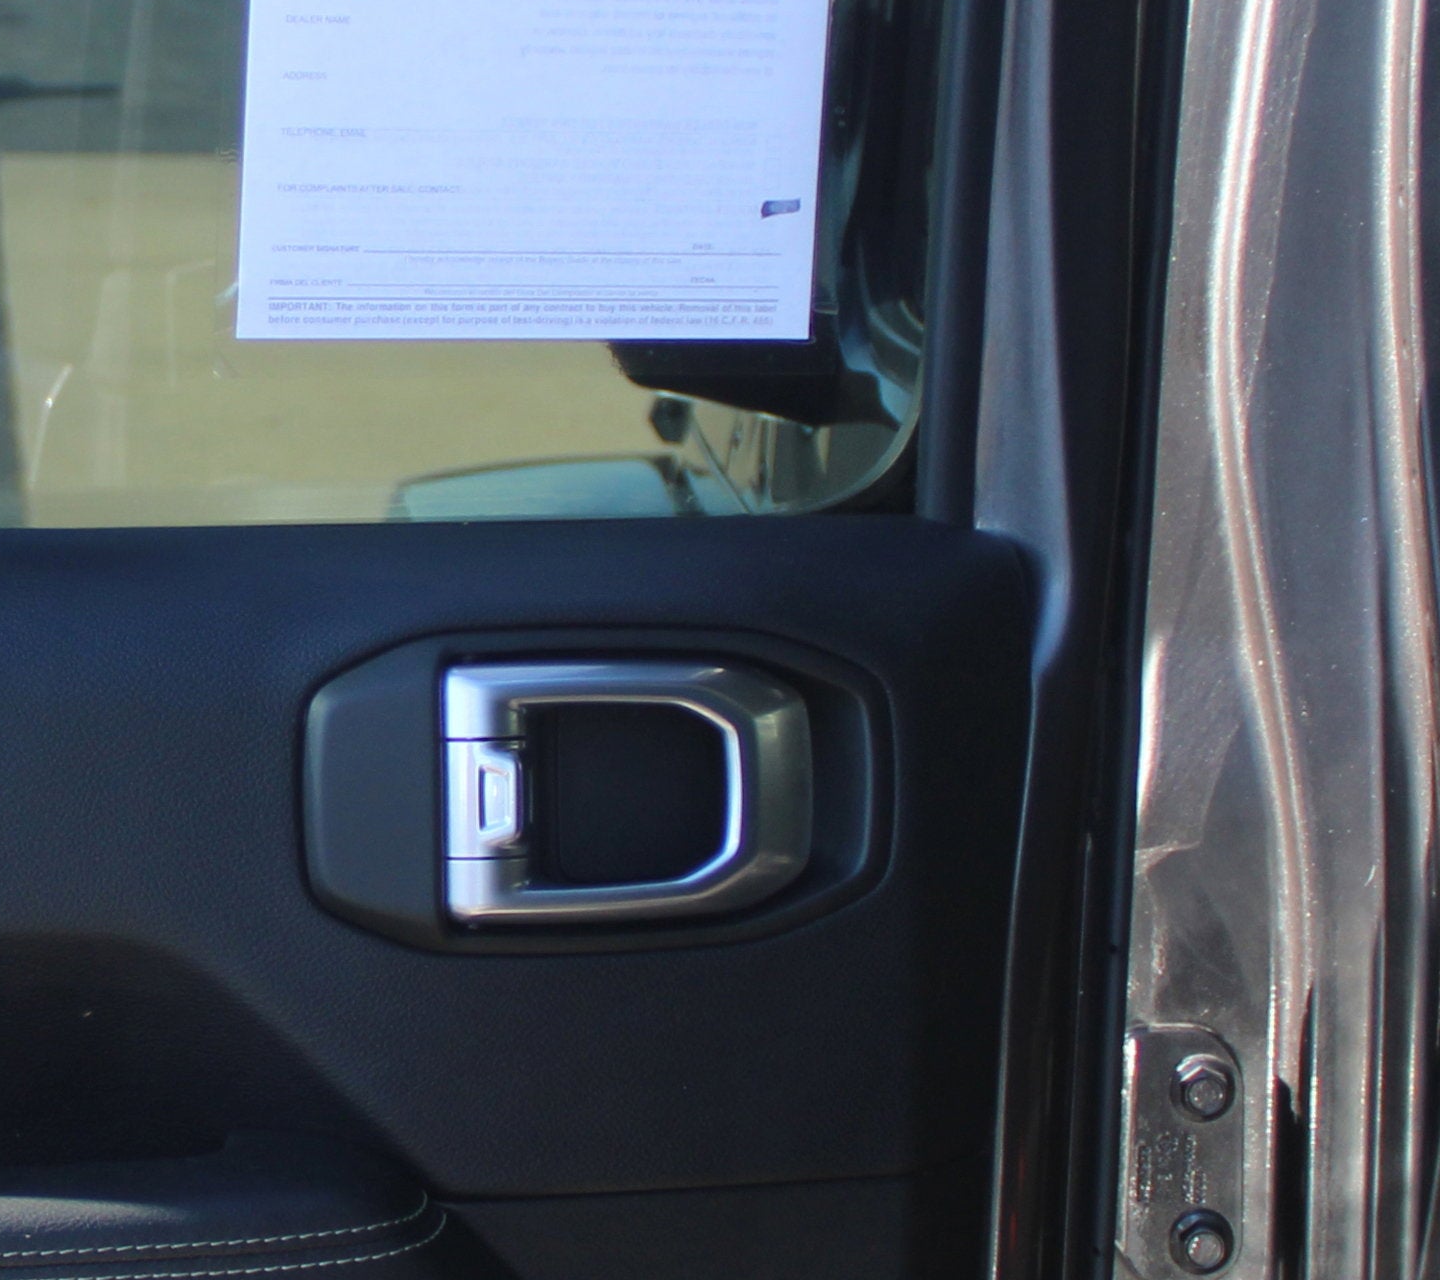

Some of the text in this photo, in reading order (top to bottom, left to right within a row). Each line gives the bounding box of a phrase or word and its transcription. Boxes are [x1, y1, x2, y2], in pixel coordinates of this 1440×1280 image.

[285, 14, 352, 24] DEALER NAME
[282, 71, 328, 80] ADDRESS
[268, 302, 330, 311] IMPORTANT:
[336, 302, 352, 311] The
[356, 302, 412, 311] information
[430, 303, 448, 311] this
[452, 303, 474, 311] form
[476, 303, 485, 311] is
[489, 303, 508, 313] part
[511, 303, 521, 311] of
[524, 305, 540, 313] any
[544, 303, 583, 311] contract
[586, 303, 596, 311] to
[598, 303, 615, 314] buy
[619, 303, 636, 312] this
[679, 303, 719, 312] Removal
[722, 304, 733, 312] of
[734, 304, 752, 312] this
[754, 304, 776, 312] label
[268, 315, 300, 324] before
[354, 315, 400, 326] purchase
[403, 315, 440, 326] (except
[442, 315, 456, 324] for
[458, 317, 498, 326] purpose
[501, 316, 511, 324] of
[513, 316, 573, 326] test-driving)
[575, 316, 583, 324] is
[594, 316, 636, 324] violation
[638, 316, 649, 324] of
[650, 316, 683, 324] federal
[686, 316, 702, 324] law
